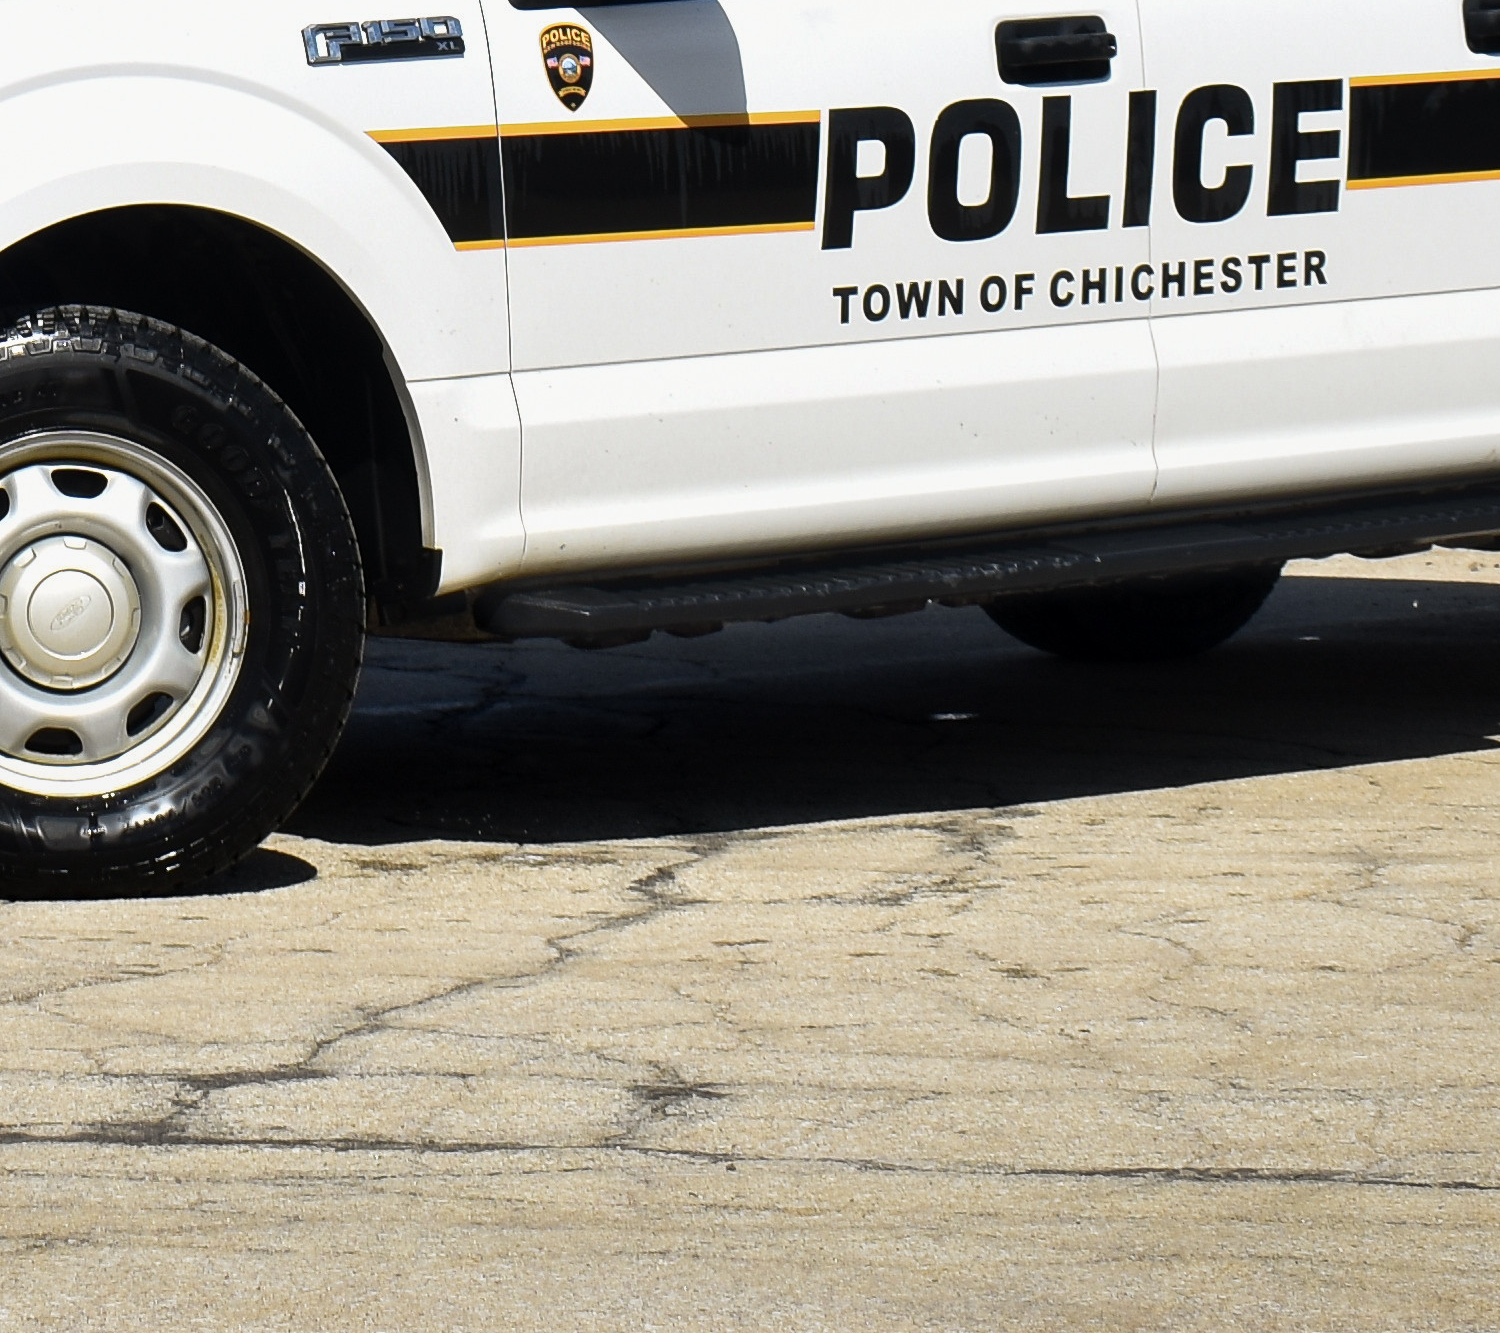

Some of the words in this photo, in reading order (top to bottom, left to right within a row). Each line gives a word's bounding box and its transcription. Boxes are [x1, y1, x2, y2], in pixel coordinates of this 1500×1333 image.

[436, 40, 460, 52] XL
[541, 27, 591, 49] POLICE
[821, 78, 1343, 250] POLICE
[832, 278, 965, 325] TOWN
[978, 273, 1036, 313] OF
[1049, 249, 1329, 308] CHICHESTER
